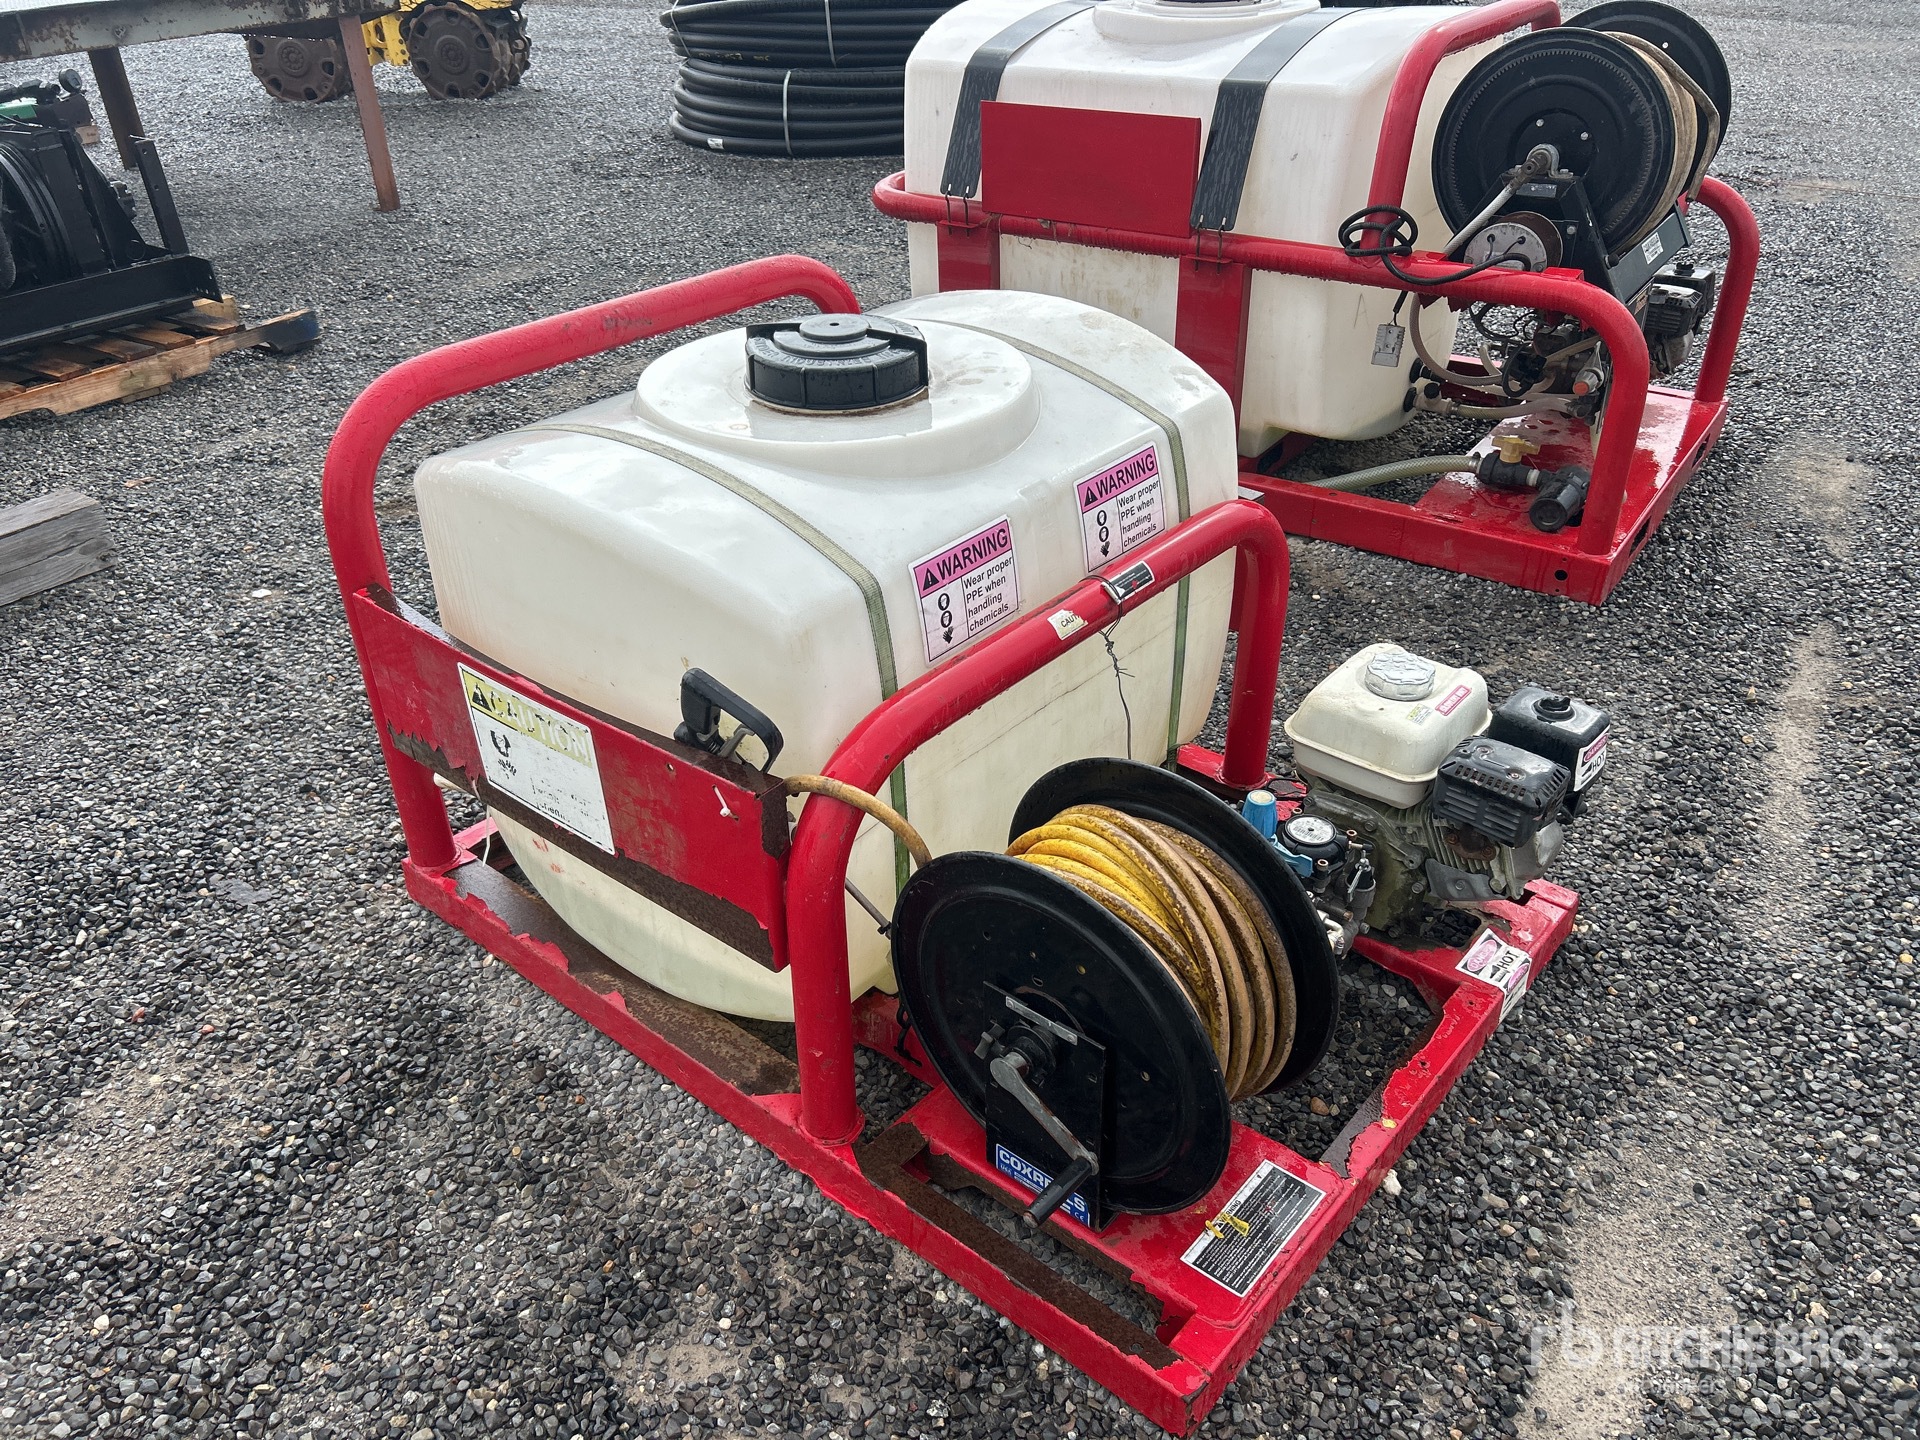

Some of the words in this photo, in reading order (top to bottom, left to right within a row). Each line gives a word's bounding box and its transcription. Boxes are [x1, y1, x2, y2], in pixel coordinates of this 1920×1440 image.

[1096, 453, 1155, 498] WARNING
[1118, 493, 1136, 508] Wear
[1137, 480, 1159, 498] proper
[1120, 505, 1136, 521] PPE
[1136, 497, 1154, 511] when
[1122, 512, 1151, 535] handling
[1123, 522, 1157, 547] chemicals
[937, 528, 1008, 581] WARNING
[964, 570, 985, 589] Wear
[987, 557, 1012, 577] proper
[966, 586, 984, 604] PPE
[985, 575, 1006, 593] when
[968, 592, 1002, 618] handling
[969, 602, 1009, 632] chemicals
[488, 690, 591, 762] CAUTION
[1591, 750, 1606, 773] HOT
[1496, 950, 1520, 970] HOT
